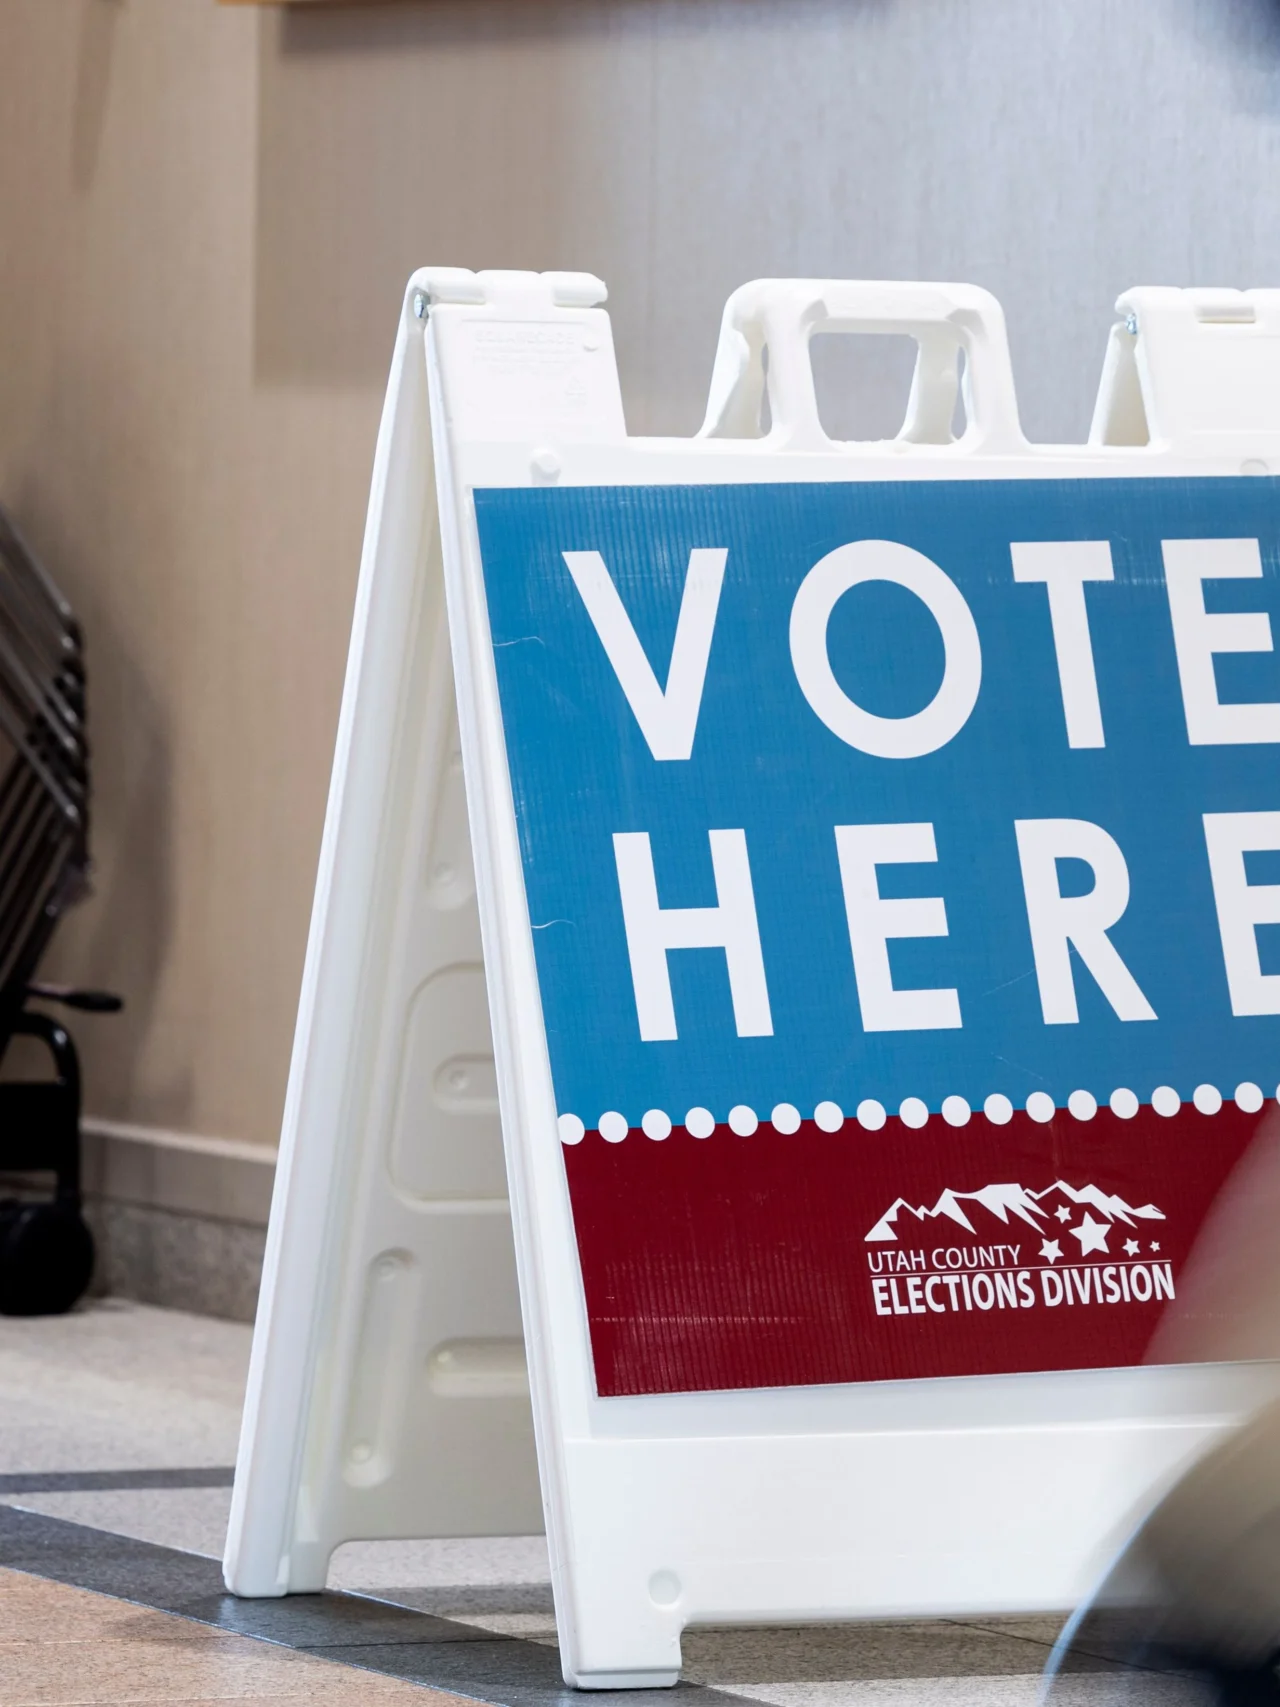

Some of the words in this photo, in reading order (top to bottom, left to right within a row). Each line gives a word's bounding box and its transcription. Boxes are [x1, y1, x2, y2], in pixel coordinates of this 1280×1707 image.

[867, 1250, 926, 1273] UTAH
[931, 1244, 1021, 1270] COUNTY
[871, 1270, 1035, 1316] ELECTIONS
[1040, 1263, 1176, 1307] DIVISION
